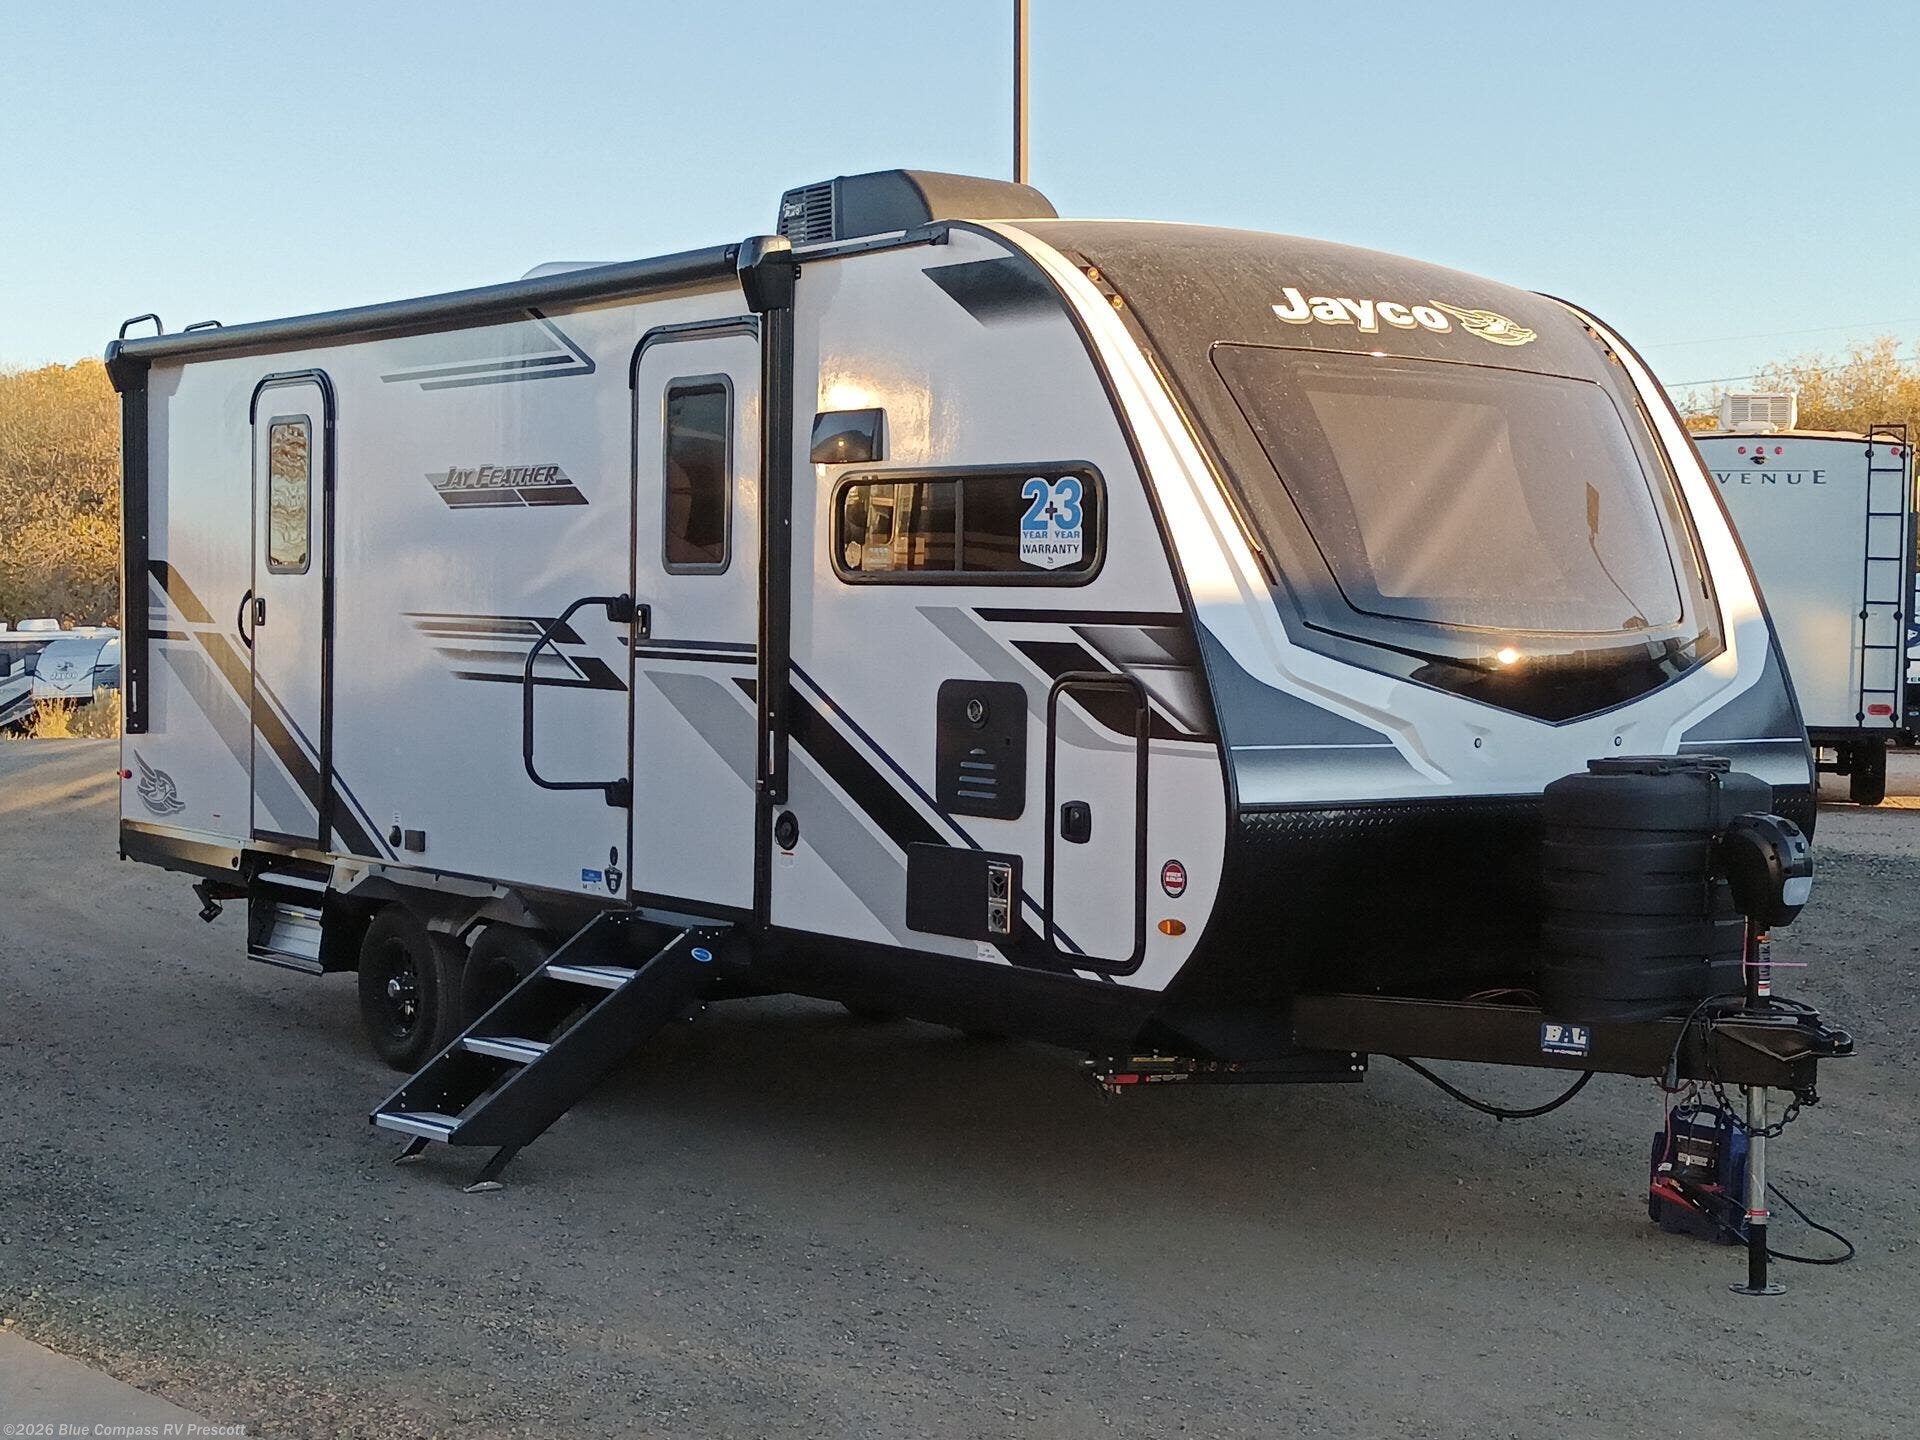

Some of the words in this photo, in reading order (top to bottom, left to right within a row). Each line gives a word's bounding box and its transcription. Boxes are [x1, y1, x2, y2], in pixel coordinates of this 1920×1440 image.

[1272, 287, 1452, 334] Jayco
[437, 466, 475, 489] JAY
[474, 463, 559, 488] FEATHER
[1023, 531, 1048, 539] YEAR
[1055, 531, 1080, 539] YEAR
[1022, 544, 1080, 554] WARRANTY
